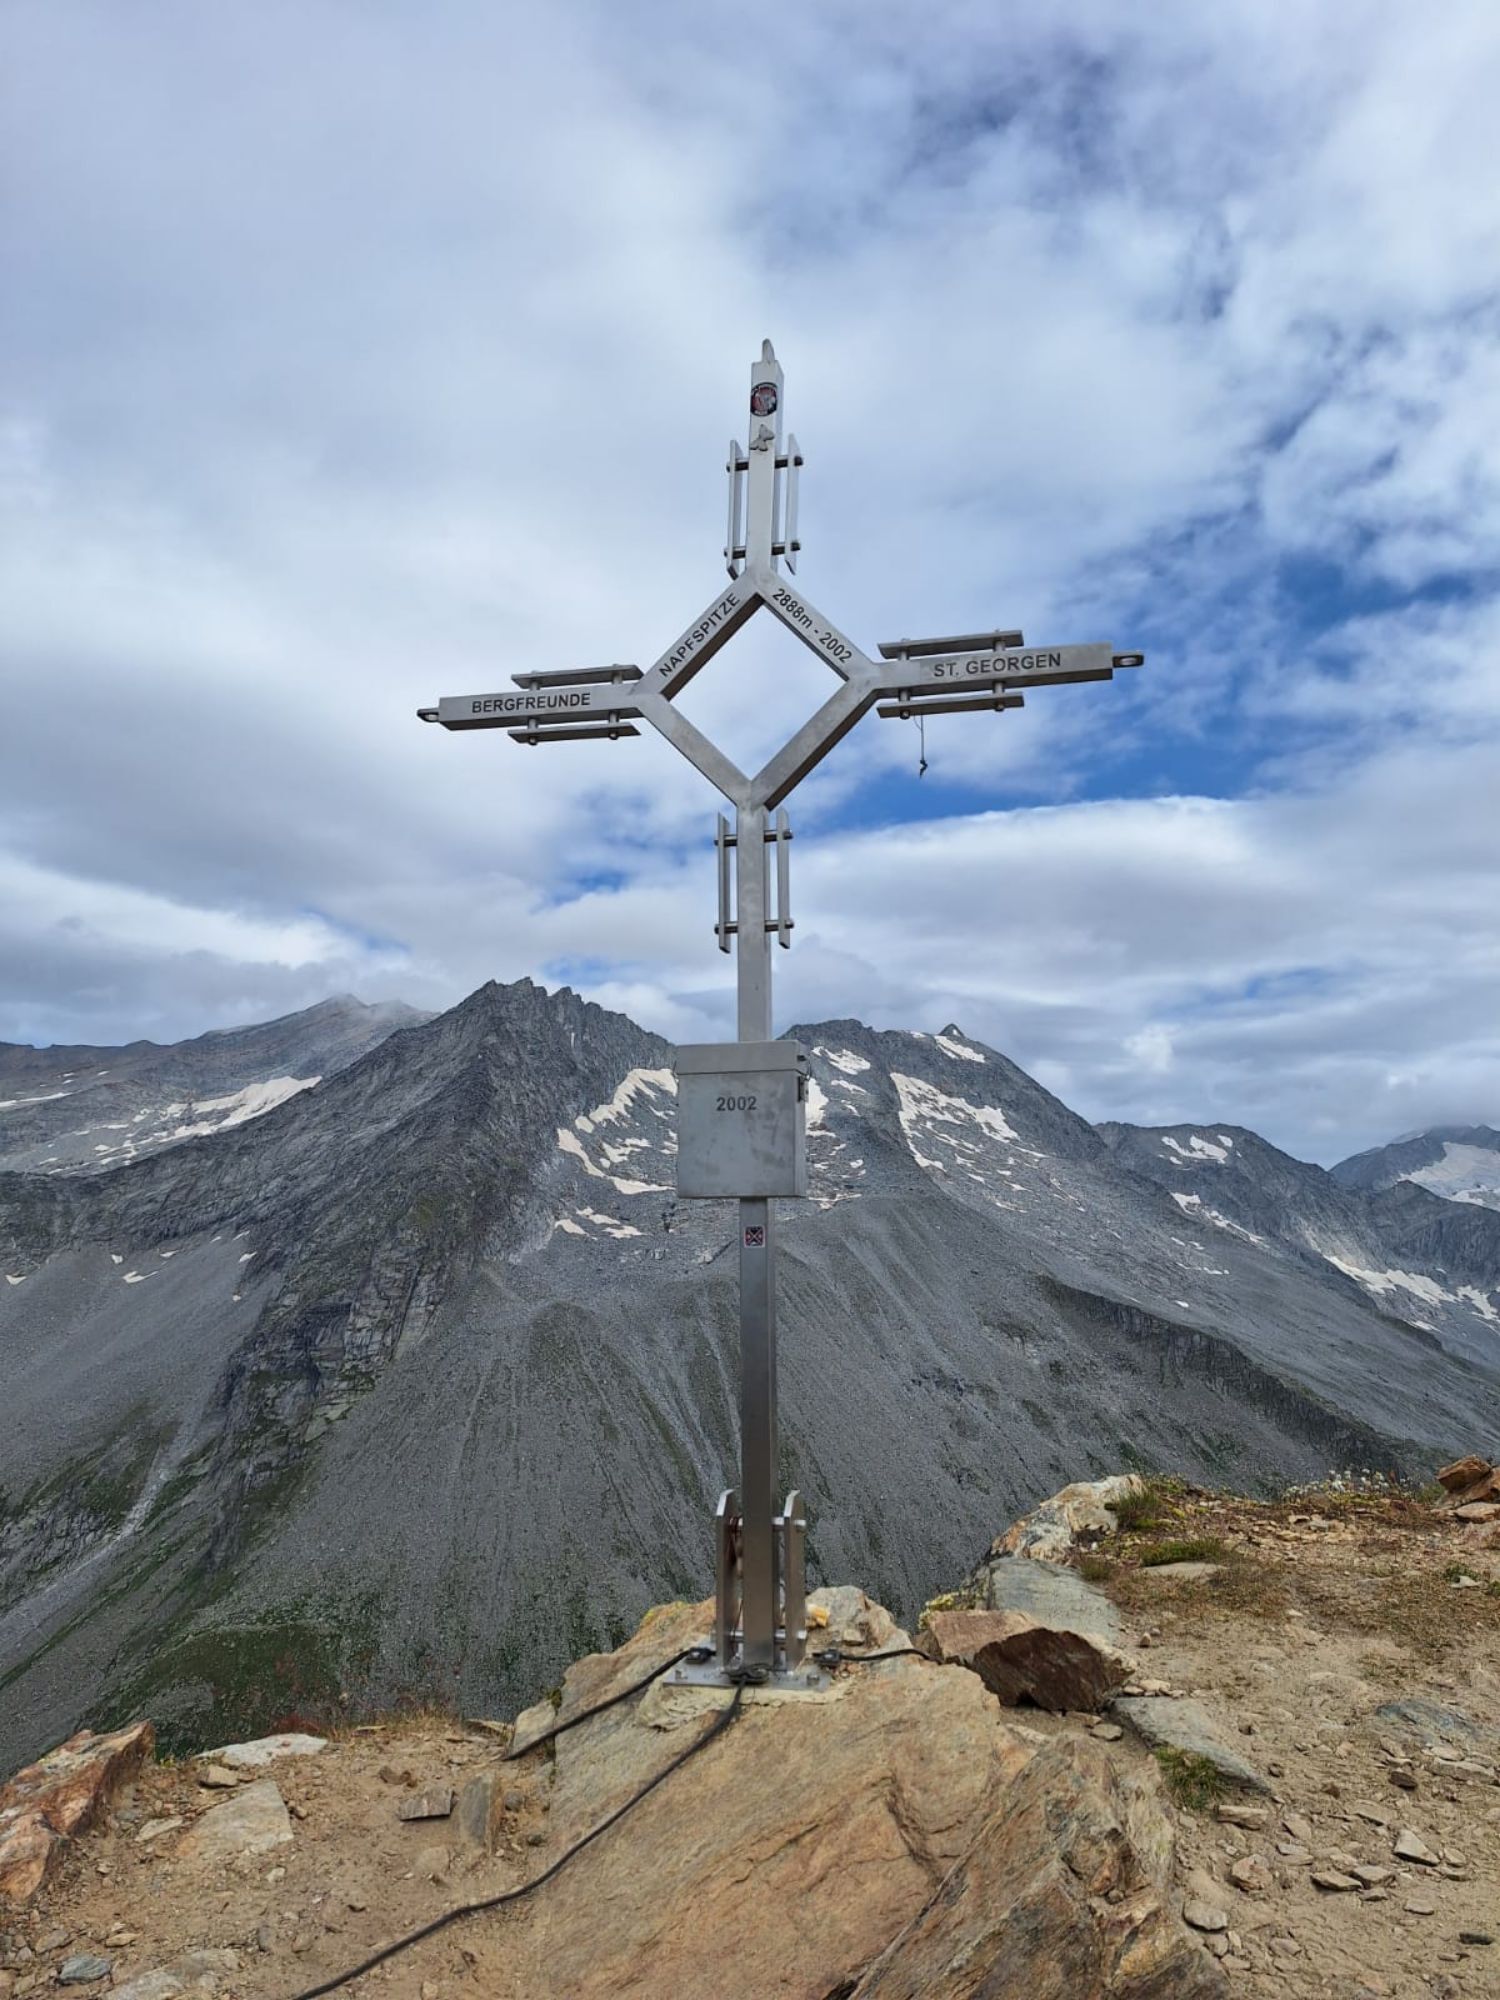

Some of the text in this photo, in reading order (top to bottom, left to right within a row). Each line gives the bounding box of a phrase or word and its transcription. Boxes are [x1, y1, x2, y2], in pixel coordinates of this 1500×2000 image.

[658, 592, 741, 677] NAPFSPITZE
[772, 588, 813, 629] 2888m
[819, 632, 853, 664] 2002
[933, 653, 1061, 677] ST. GEORGEN
[471, 692, 591, 714] BERGFREUNDE
[716, 1096, 758, 1112] 2002
